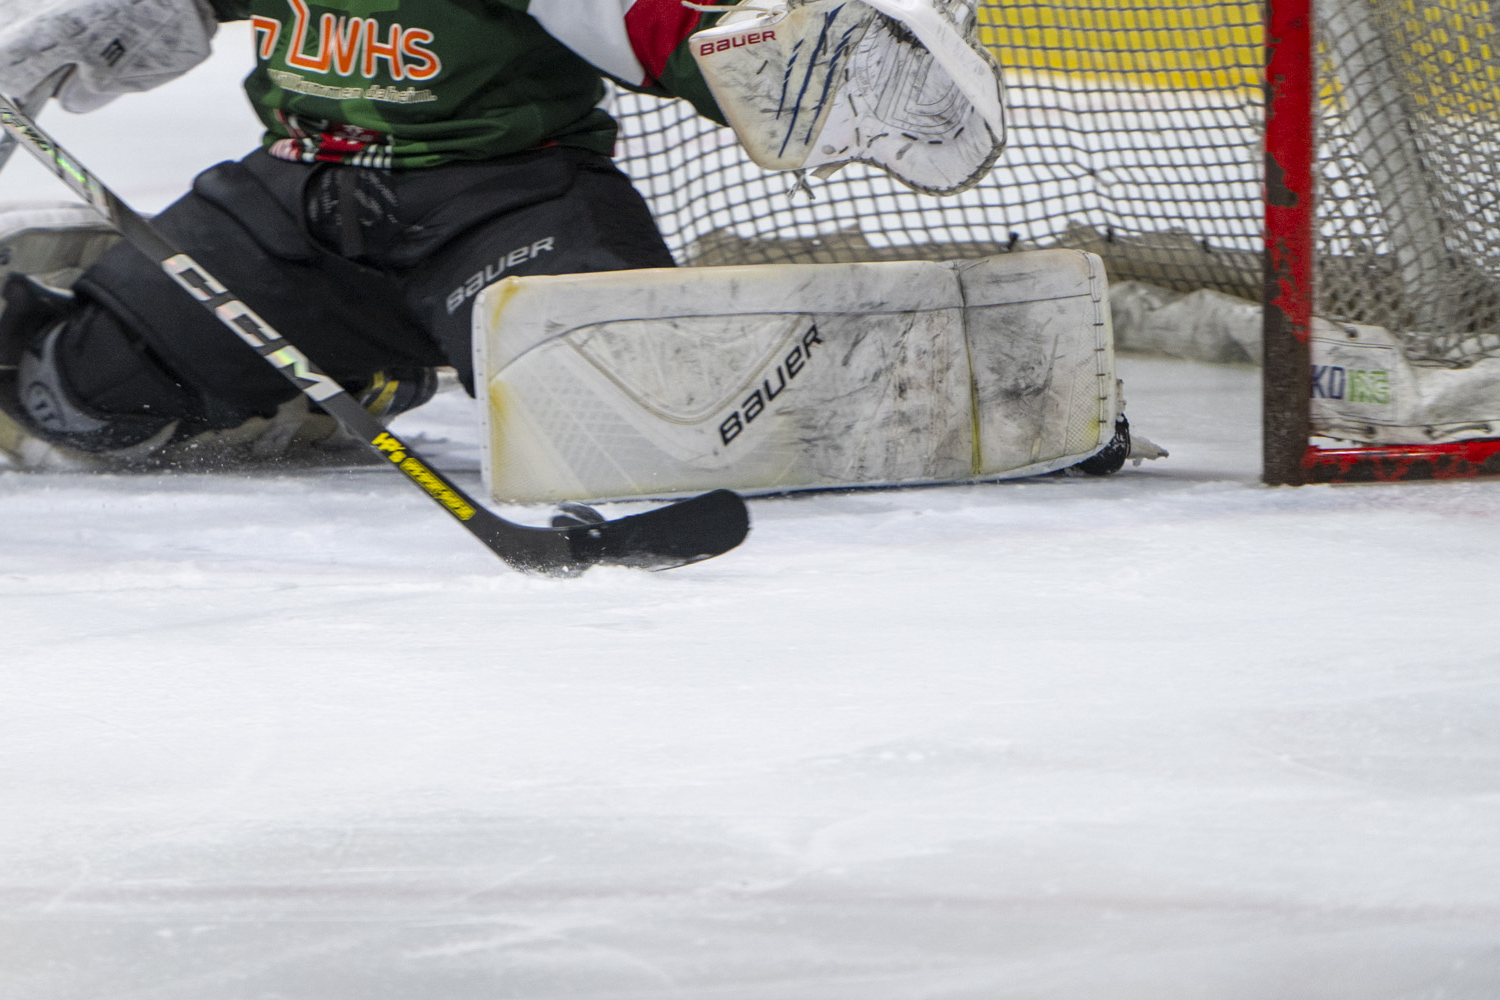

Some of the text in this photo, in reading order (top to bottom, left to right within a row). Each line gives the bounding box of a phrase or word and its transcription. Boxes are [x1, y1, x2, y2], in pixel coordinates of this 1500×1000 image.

[700, 29, 777, 57] BAUER
[446, 235, 555, 315] BAUER
[161, 253, 346, 402] CCM
[717, 323, 824, 448] BAUER
